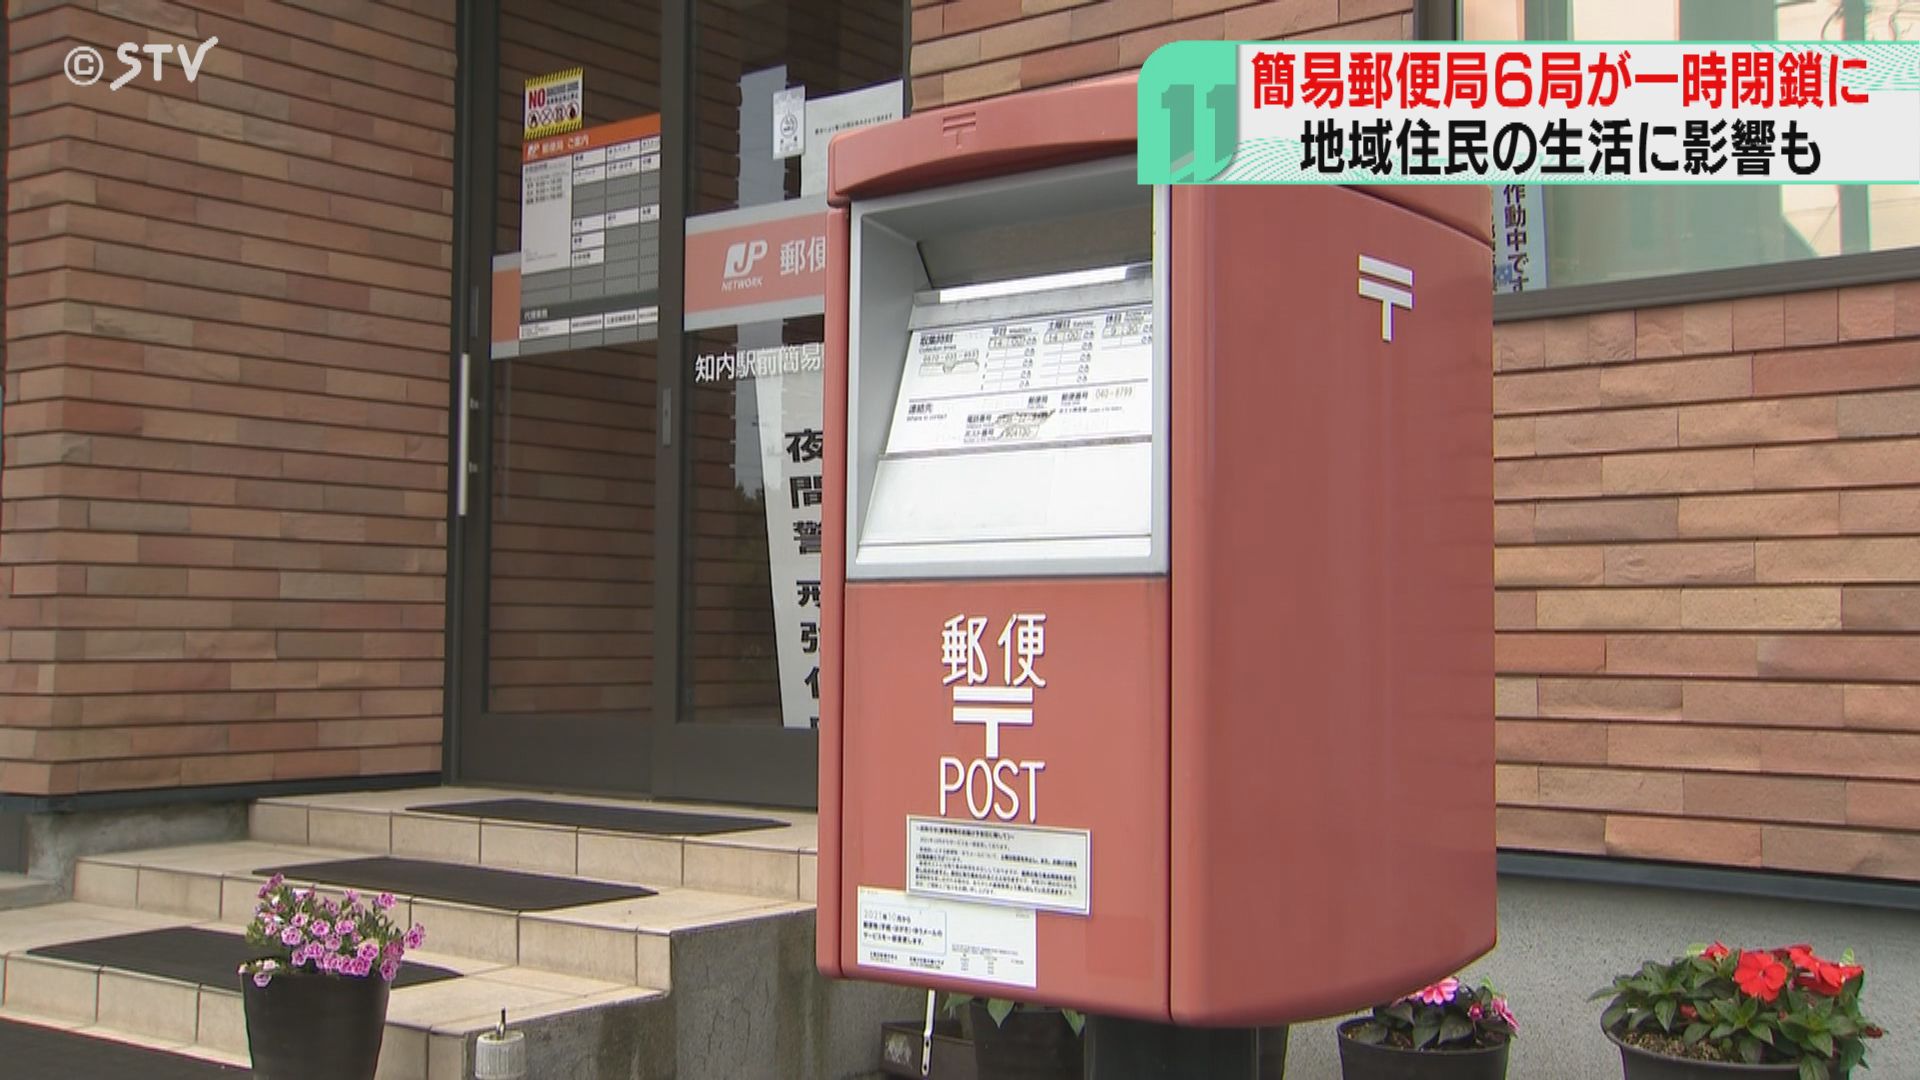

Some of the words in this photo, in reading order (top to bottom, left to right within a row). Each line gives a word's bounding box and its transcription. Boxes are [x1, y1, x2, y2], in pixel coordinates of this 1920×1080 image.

[529, 88, 546, 109] NO
[721, 277, 763, 292] NETWORK
[695, 342, 825, 384] 知内駅前簡易
[942, 614, 1046, 687] 郵便
[940, 757, 1046, 823] POST
